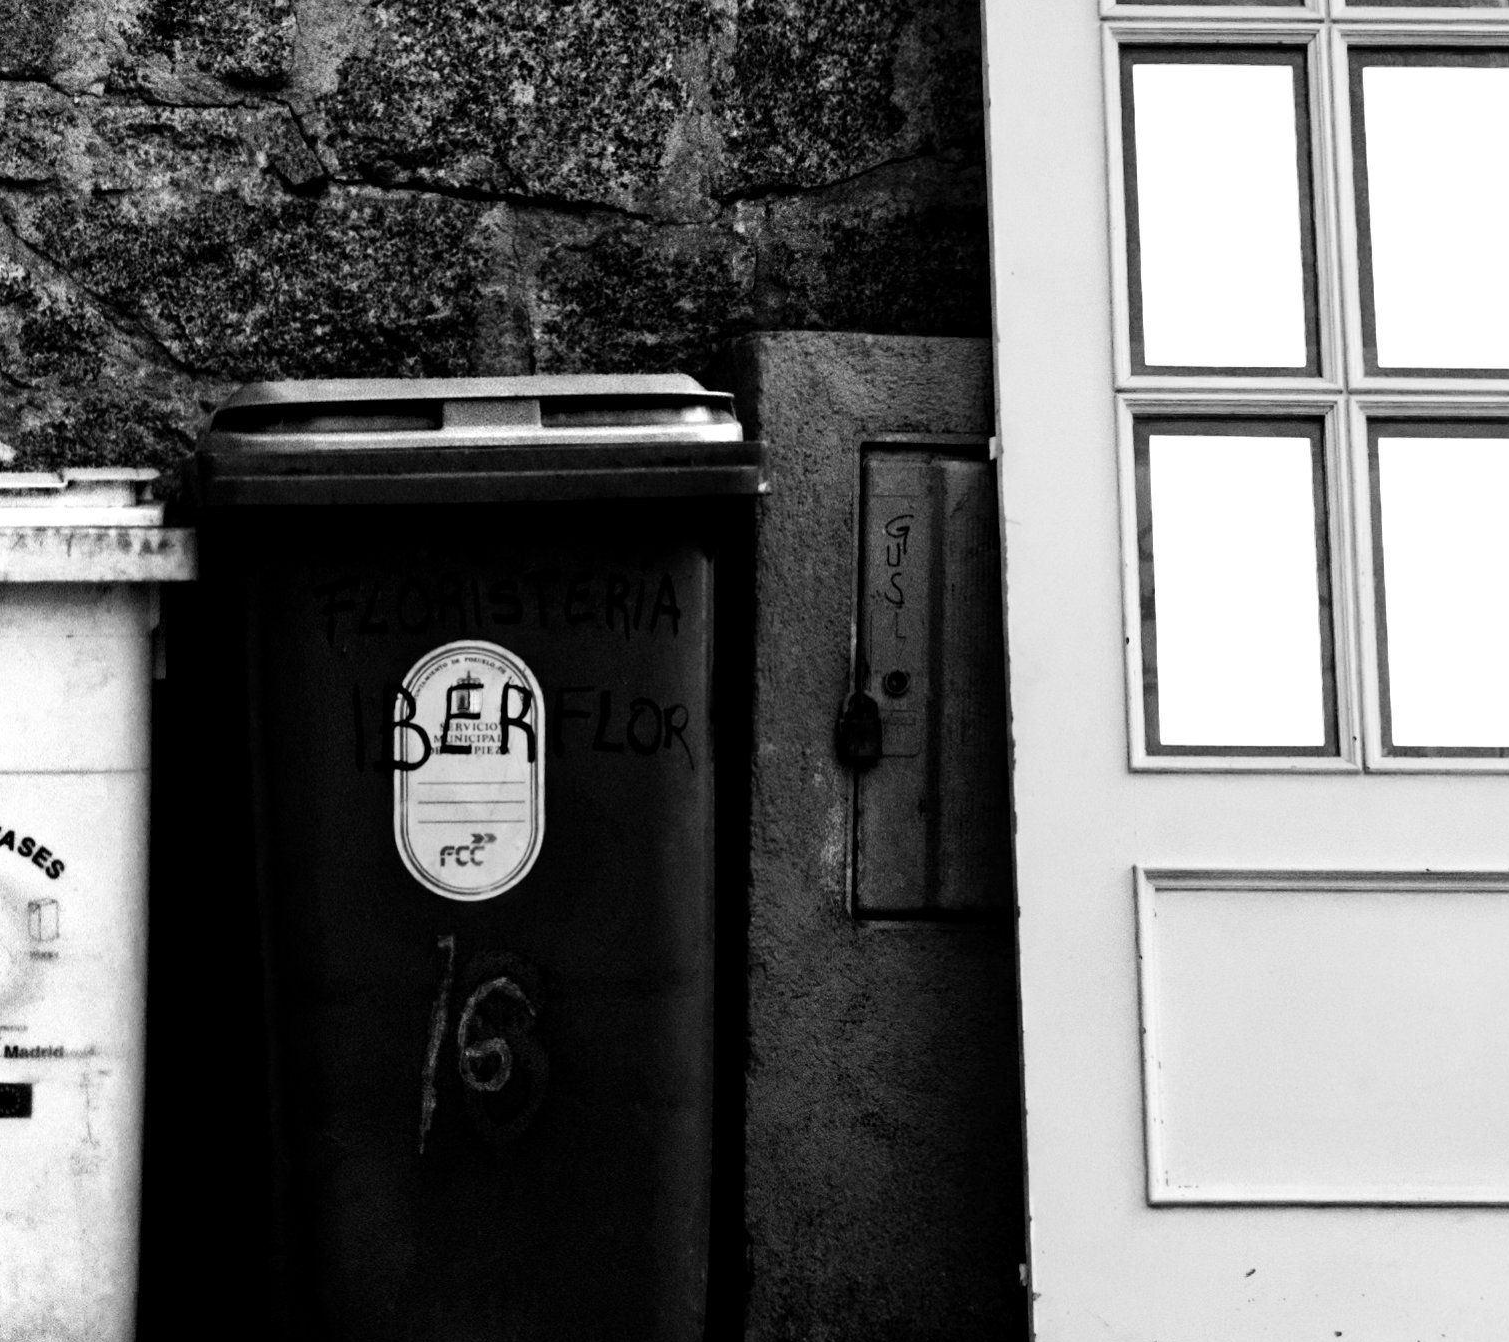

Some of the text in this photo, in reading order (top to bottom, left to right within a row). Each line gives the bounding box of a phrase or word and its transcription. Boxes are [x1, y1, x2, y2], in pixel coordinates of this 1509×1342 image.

[351, 679, 694, 780] IBERFLOR
[440, 845, 485, 867] FCC
[3, 1044, 64, 1058] Madrid
[418, 934, 537, 1155] 16
